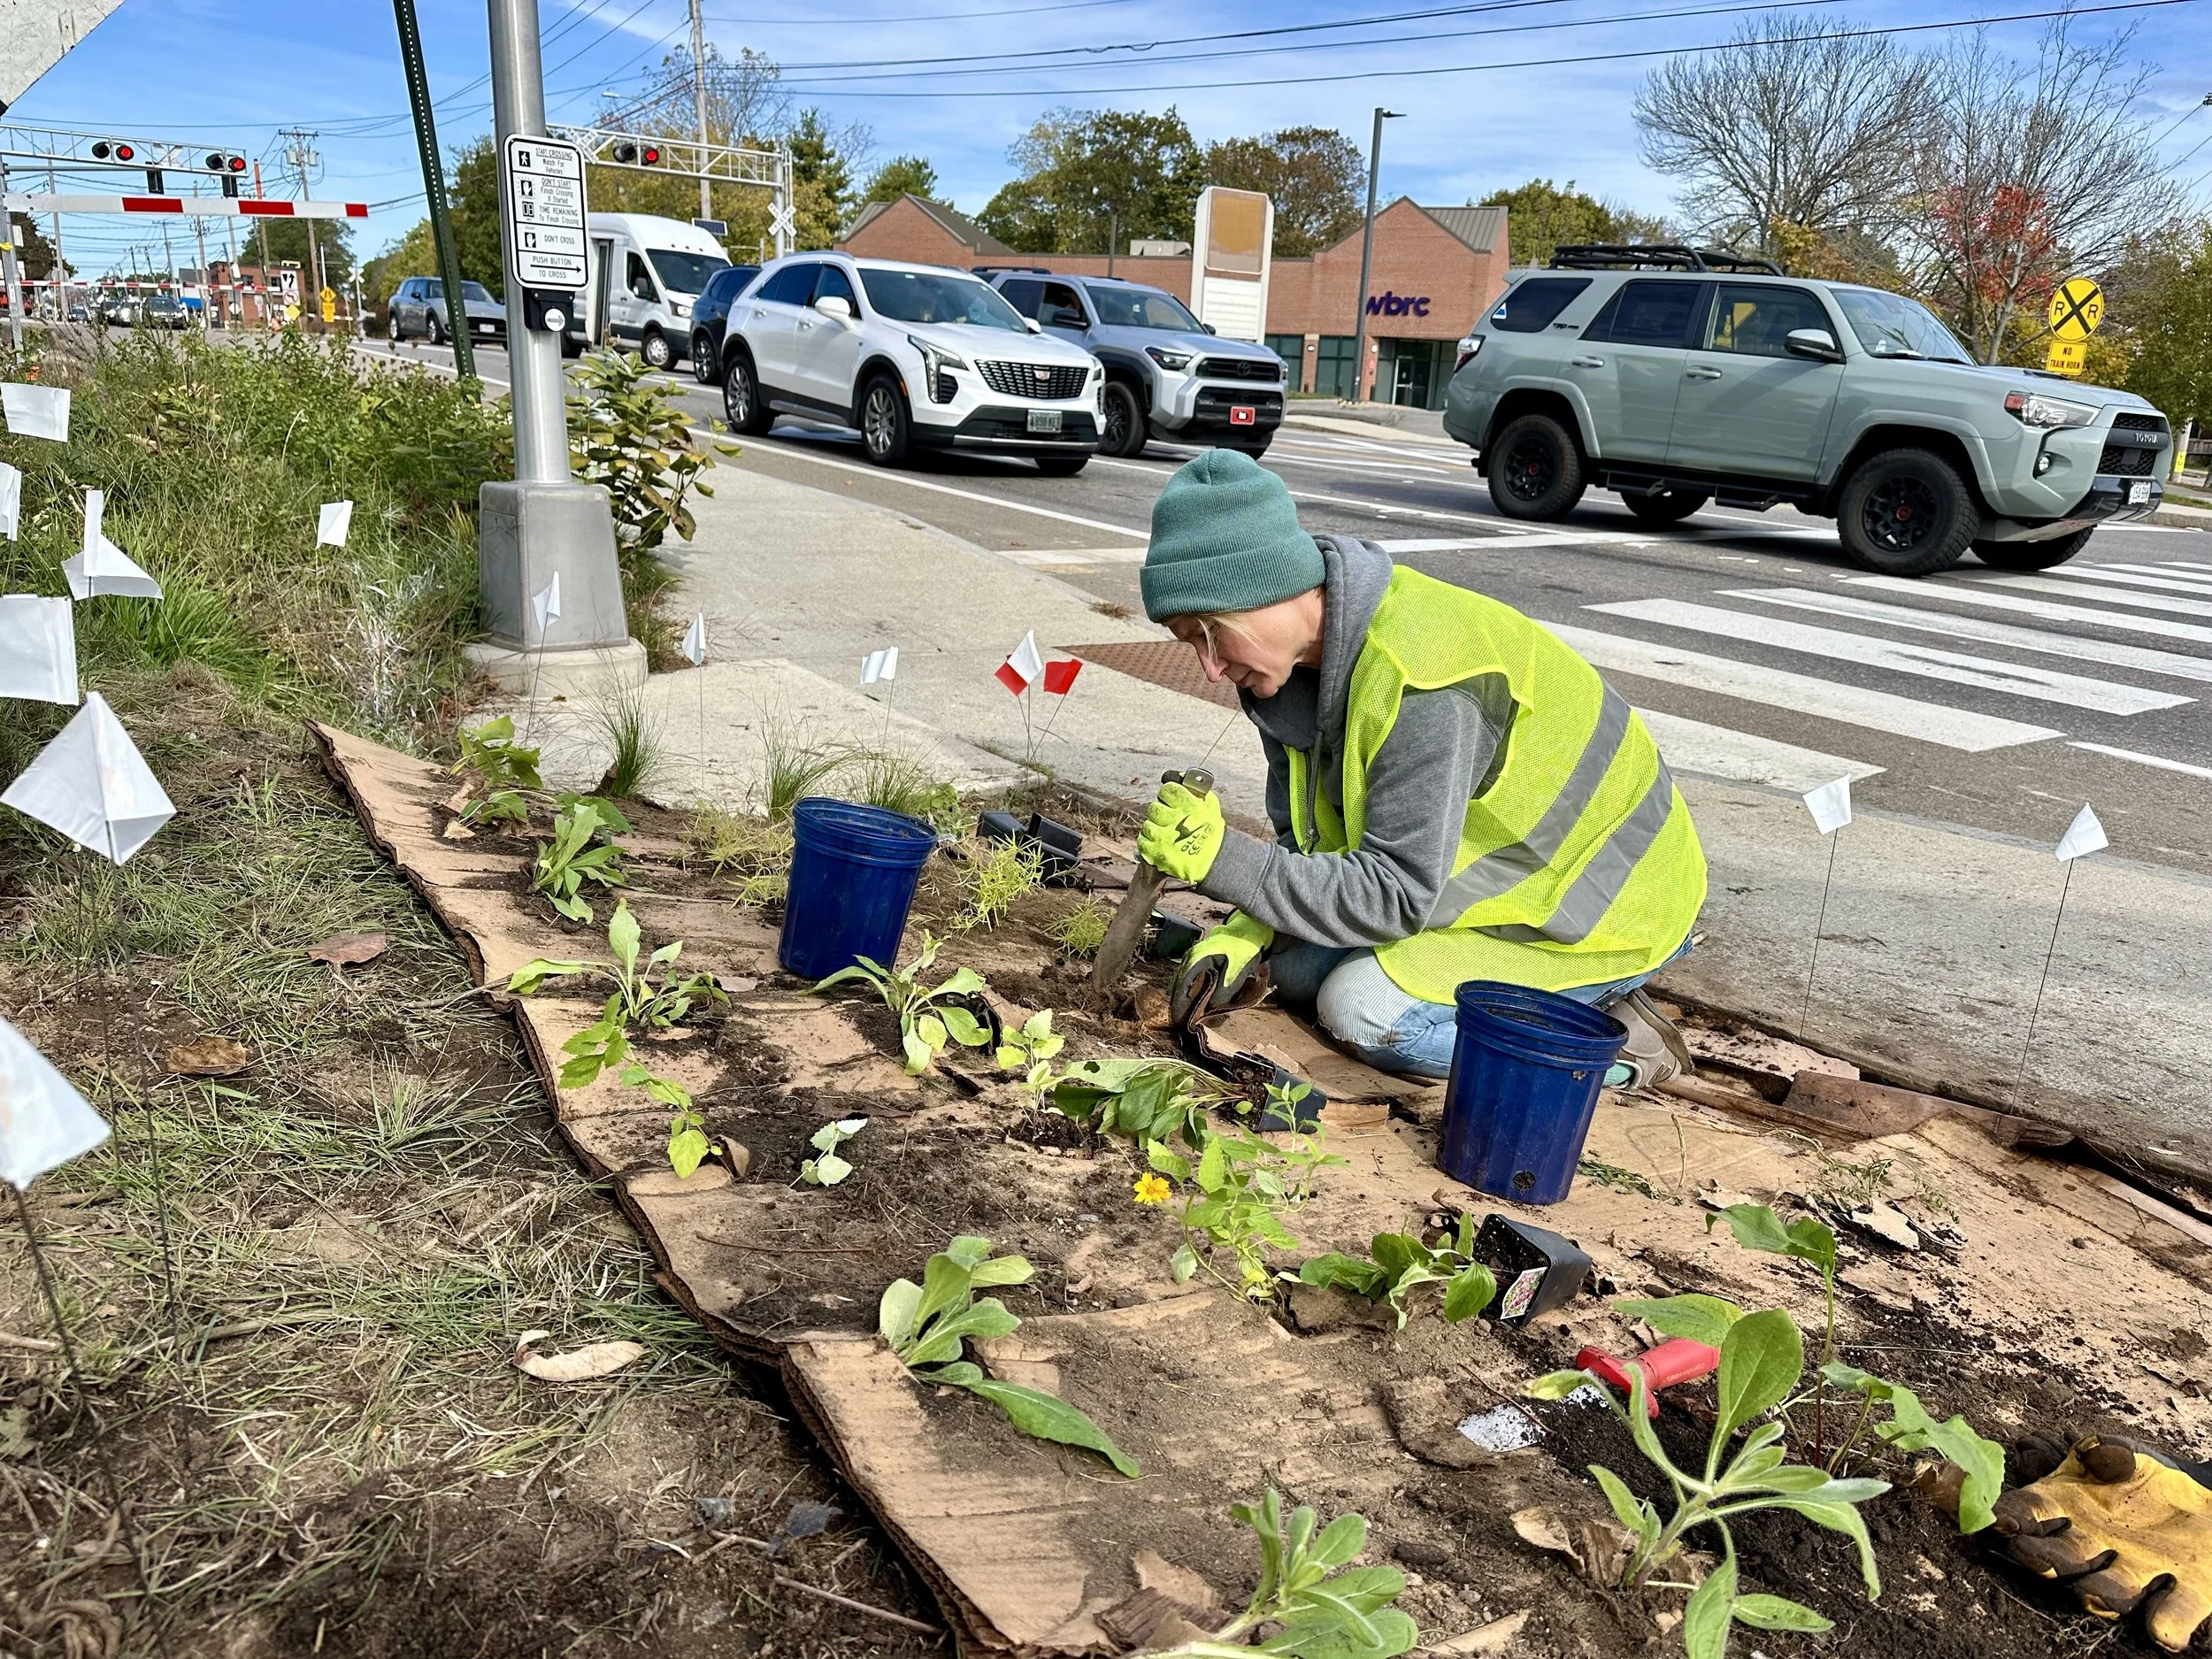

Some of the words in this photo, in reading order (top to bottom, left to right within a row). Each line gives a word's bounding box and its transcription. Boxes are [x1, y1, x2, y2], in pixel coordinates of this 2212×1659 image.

[535, 148, 548, 157] START
[549, 150, 572, 159] CROSSING
[556, 188, 573, 198] Crossing
[552, 207, 578, 217] REMAINING
[562, 216, 580, 226] Crossing
[1365, 290, 1431, 317] wbrc
[2050, 359, 2064, 368] TRAIN
[2135, 433, 2158, 443] TOYOTA
